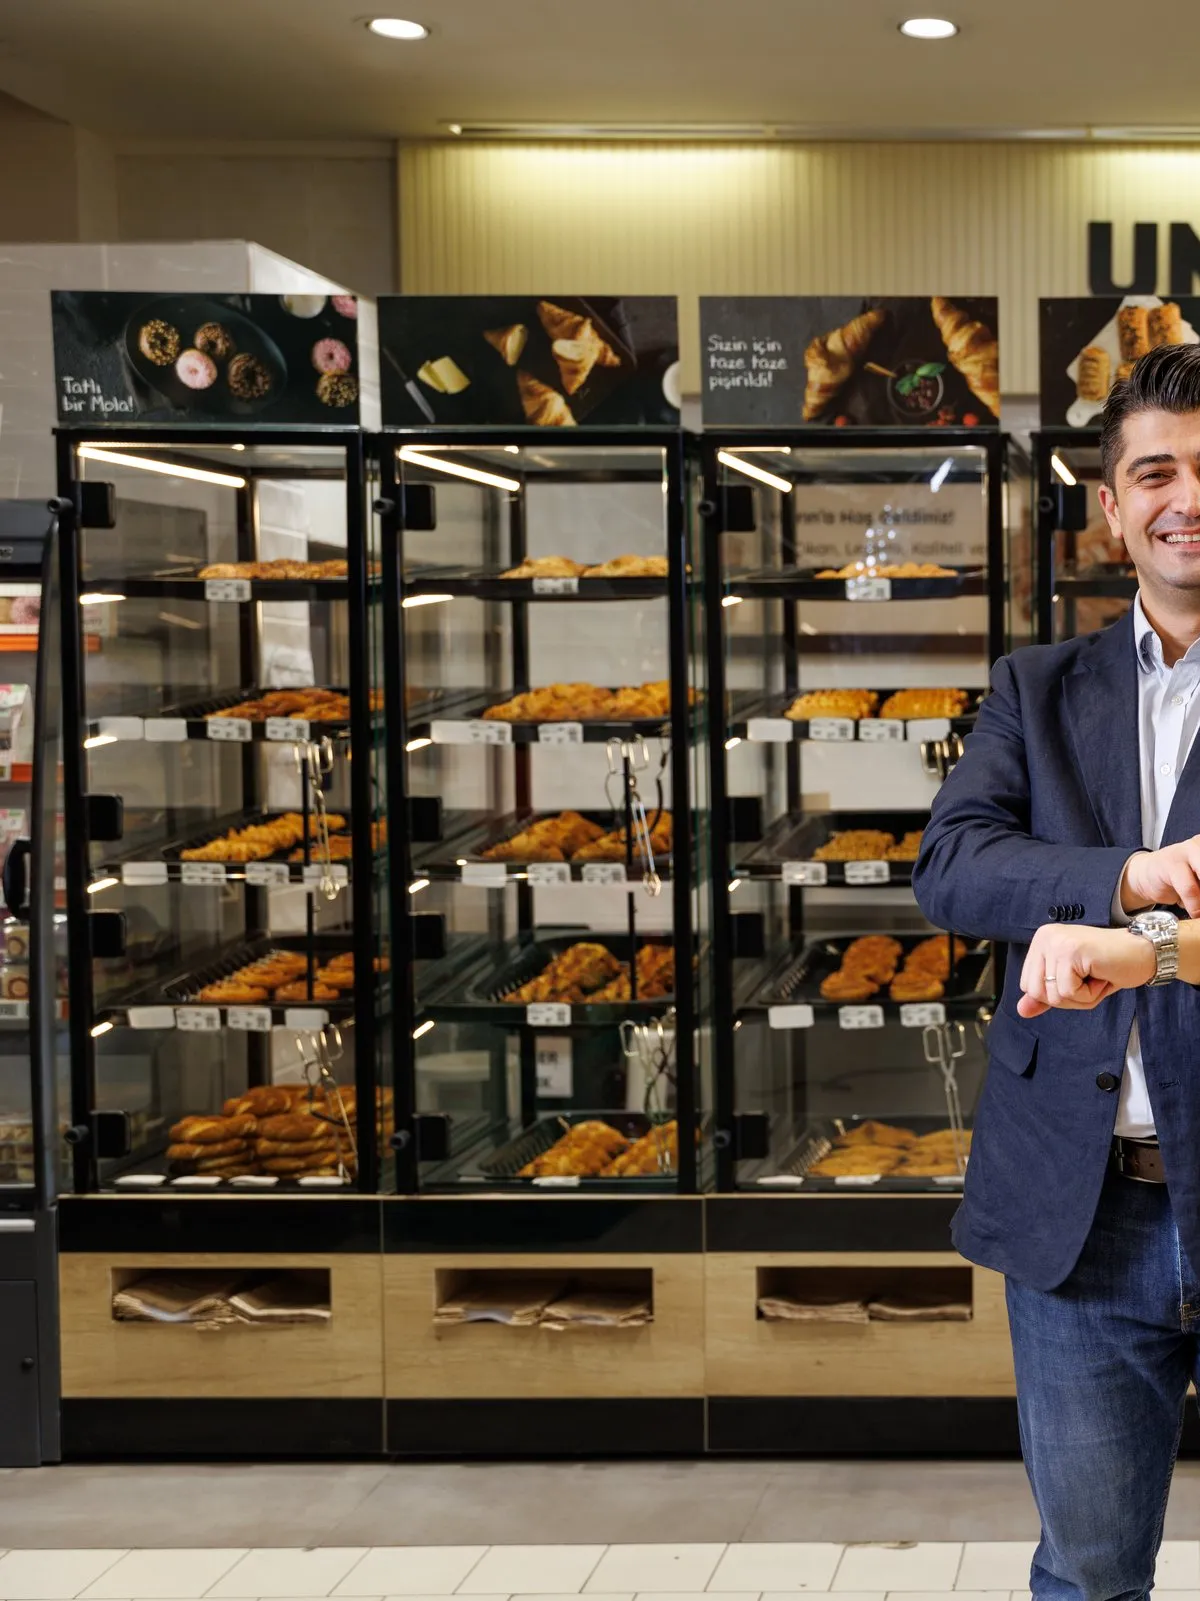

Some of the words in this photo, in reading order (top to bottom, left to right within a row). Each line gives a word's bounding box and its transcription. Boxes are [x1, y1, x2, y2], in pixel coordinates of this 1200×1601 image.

[708, 334, 748, 352] Sizin
[709, 354, 745, 370] taze
[751, 355, 788, 370] taze
[62, 376, 102, 394] Tatlı
[62, 395, 87, 412] bir
[89, 394, 134, 413] Mola!
